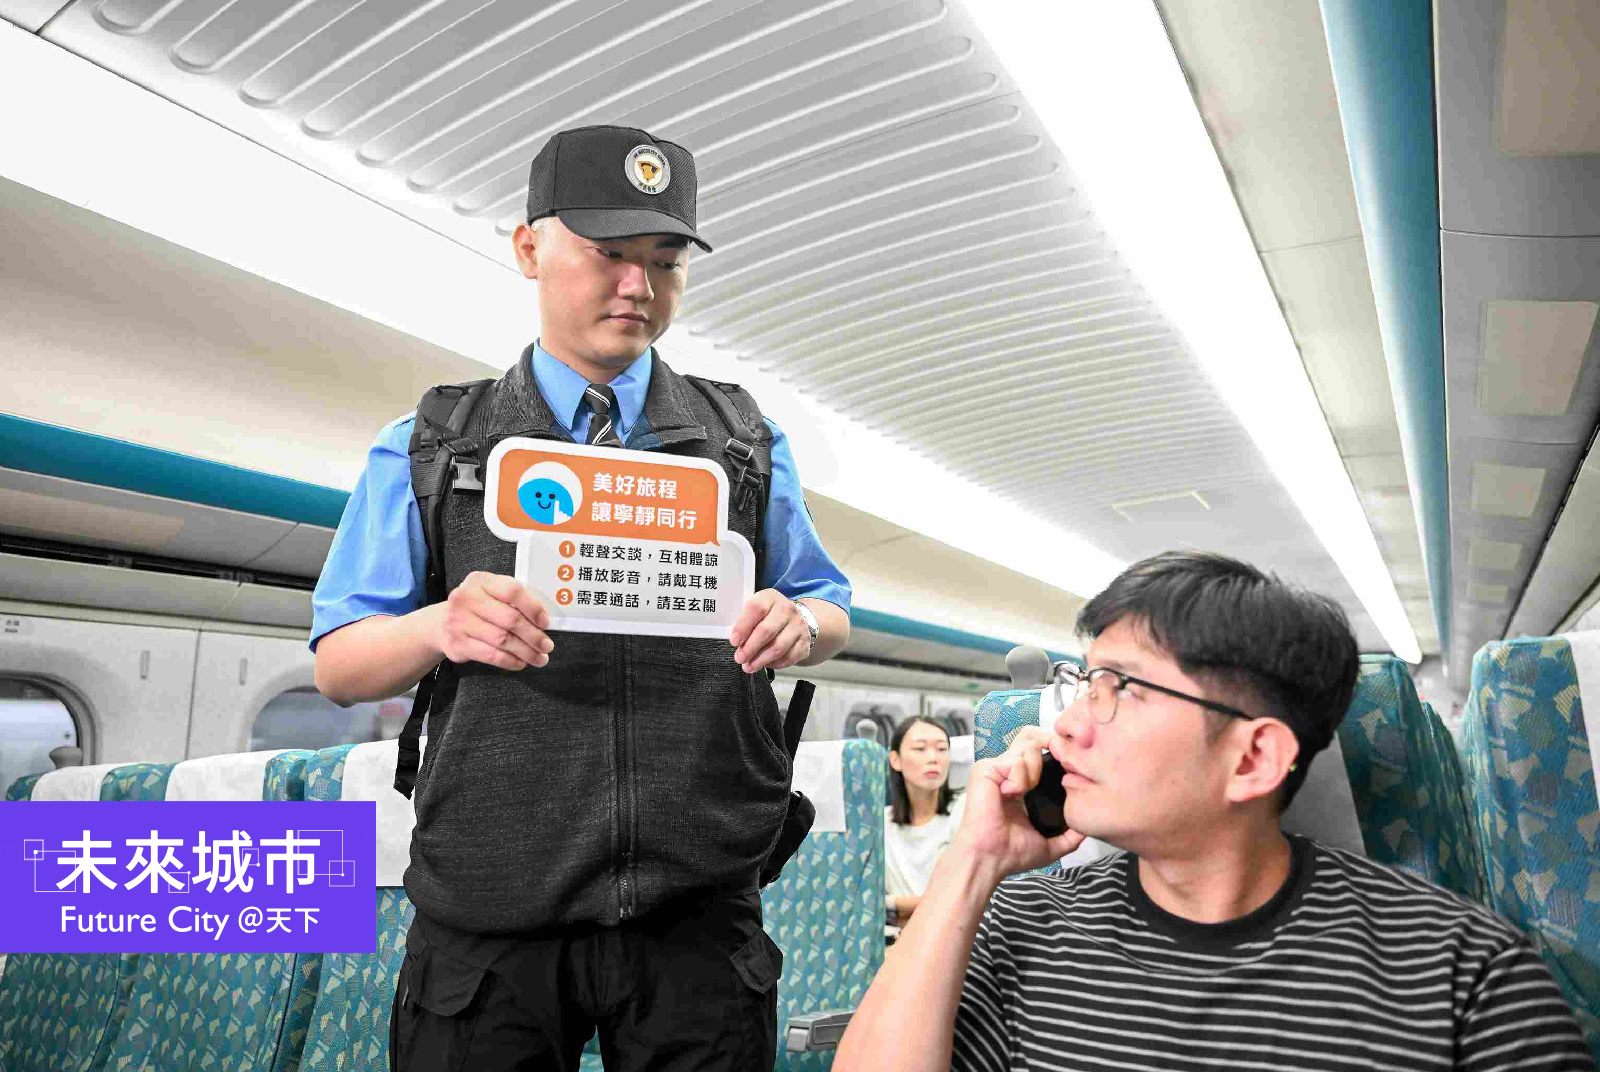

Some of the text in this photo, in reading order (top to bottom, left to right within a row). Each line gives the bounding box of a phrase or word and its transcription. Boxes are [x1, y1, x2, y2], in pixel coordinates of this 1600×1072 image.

[593, 472, 677, 499] 美好旅程
[591, 501, 697, 530] 讓寧靜同行
[579, 543, 718, 567] 輕聲交談，互相體諒
[578, 566, 718, 590] 播放影音，請戴耳機
[577, 590, 716, 613] 需要通話，請至玄關
